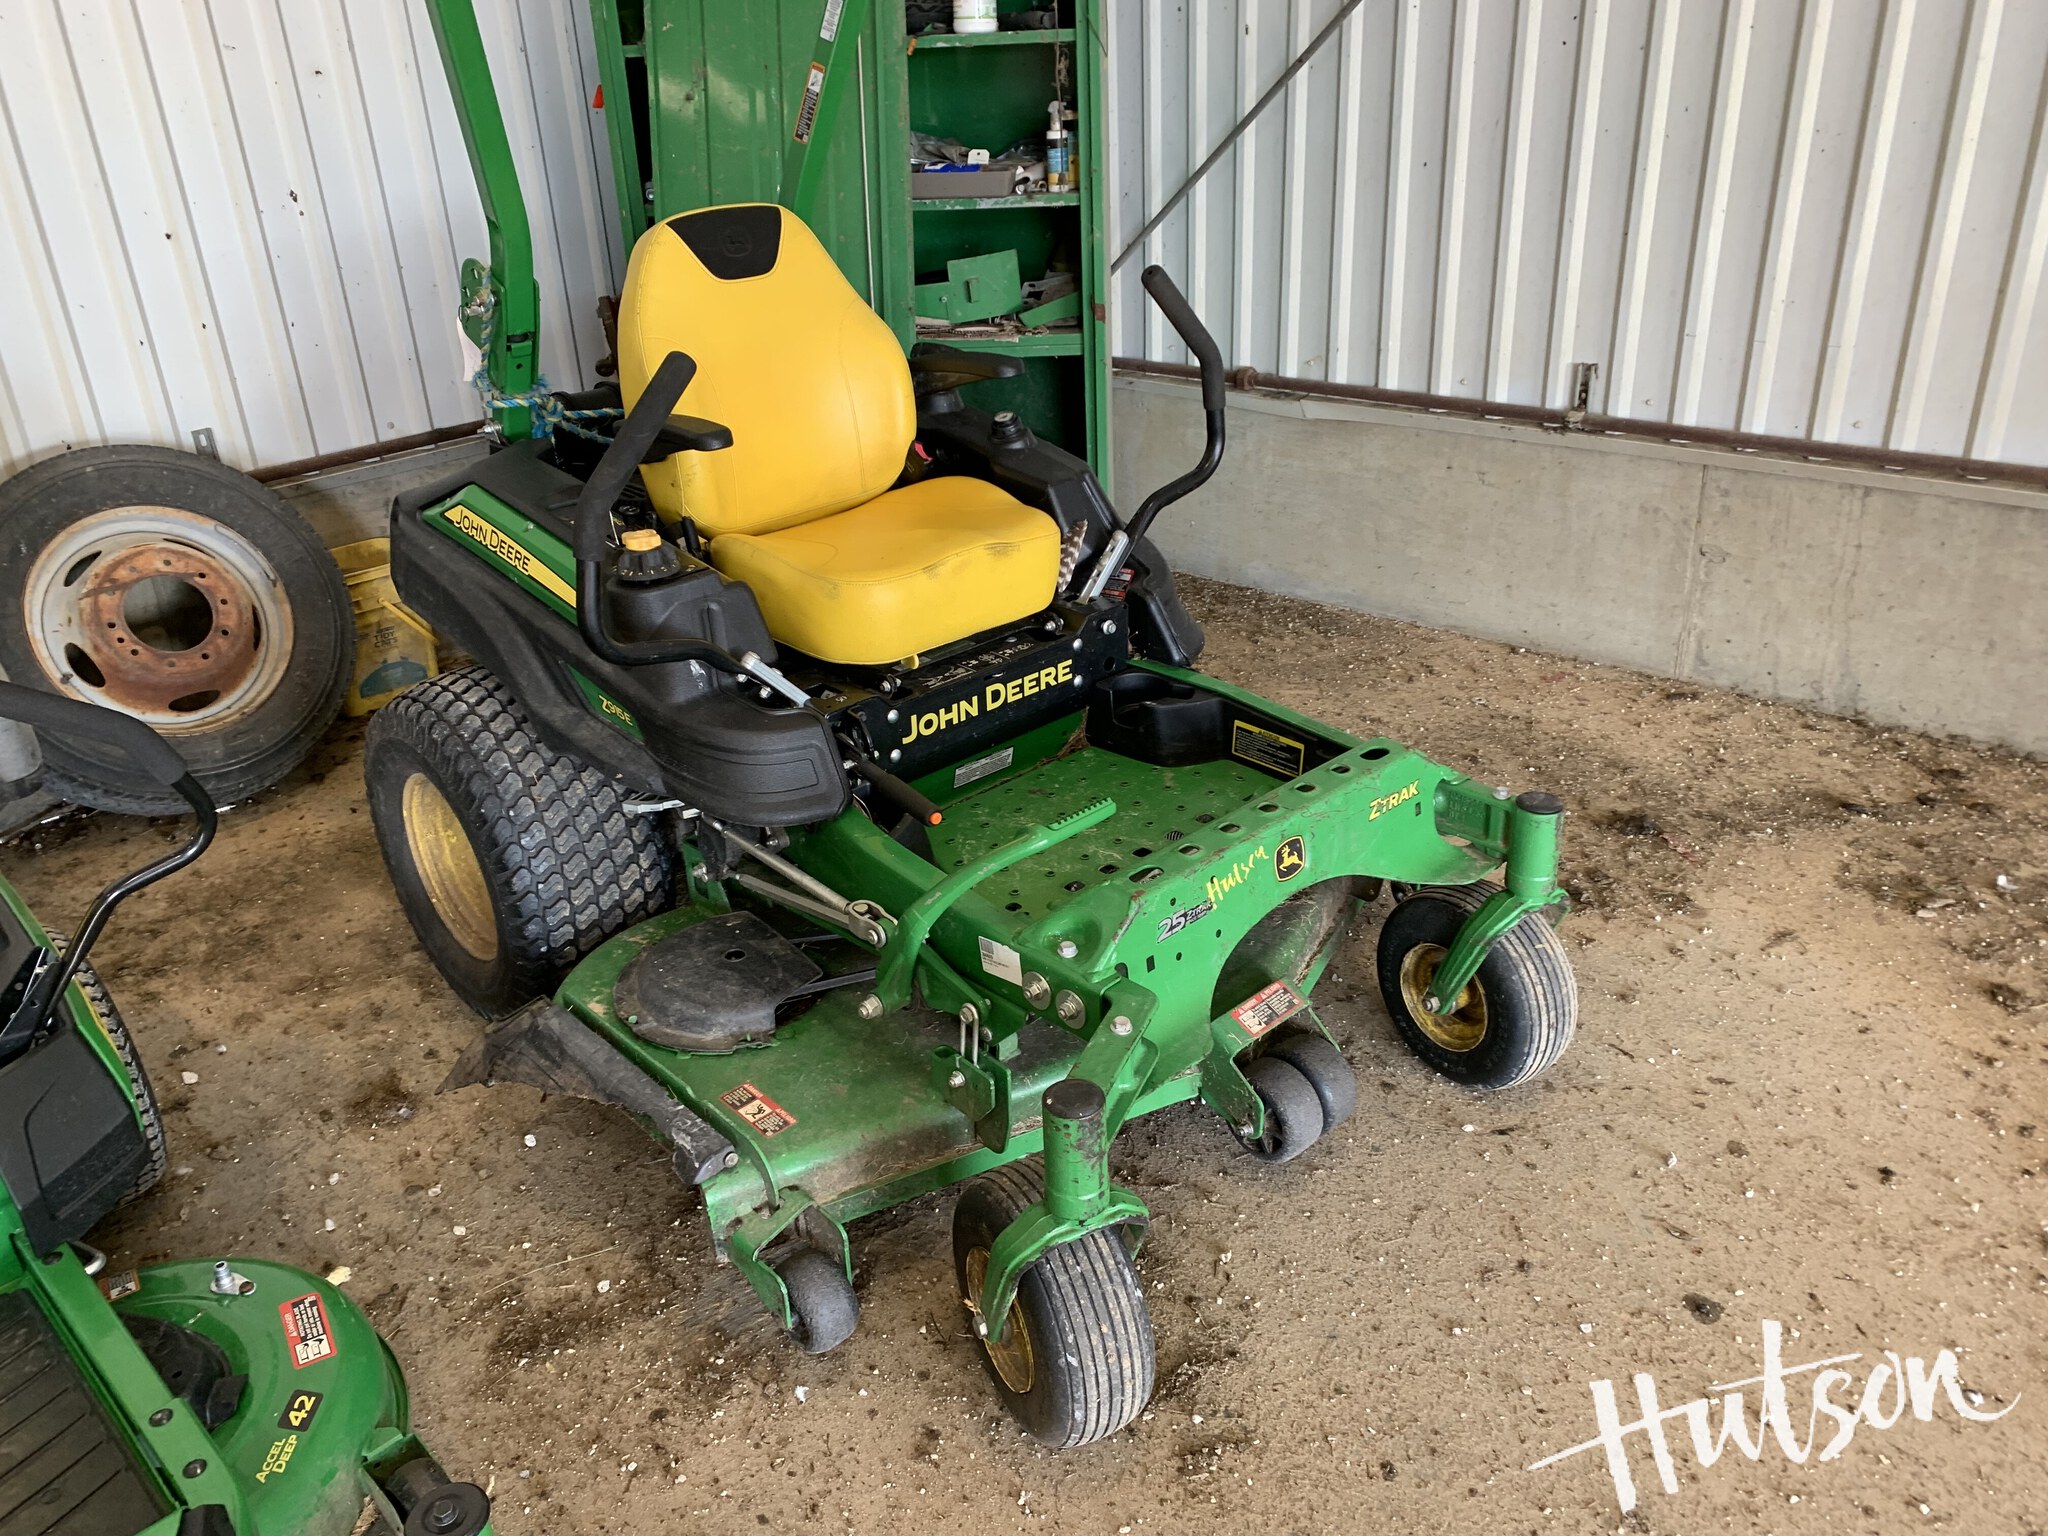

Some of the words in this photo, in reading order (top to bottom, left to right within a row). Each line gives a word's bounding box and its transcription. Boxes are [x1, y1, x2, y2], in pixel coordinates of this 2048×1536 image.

[455, 509, 488, 544] JOHN
[490, 529, 531, 573] DEERE
[902, 695, 979, 745] JOHN
[985, 659, 1073, 711] DEERE
[1369, 780, 1420, 822] ZTRAK
[1157, 909, 1186, 943] 25
[288, 1395, 316, 1427] 42
[255, 1438, 286, 1484] ACCEL
[272, 1434, 298, 1474] DEEP
